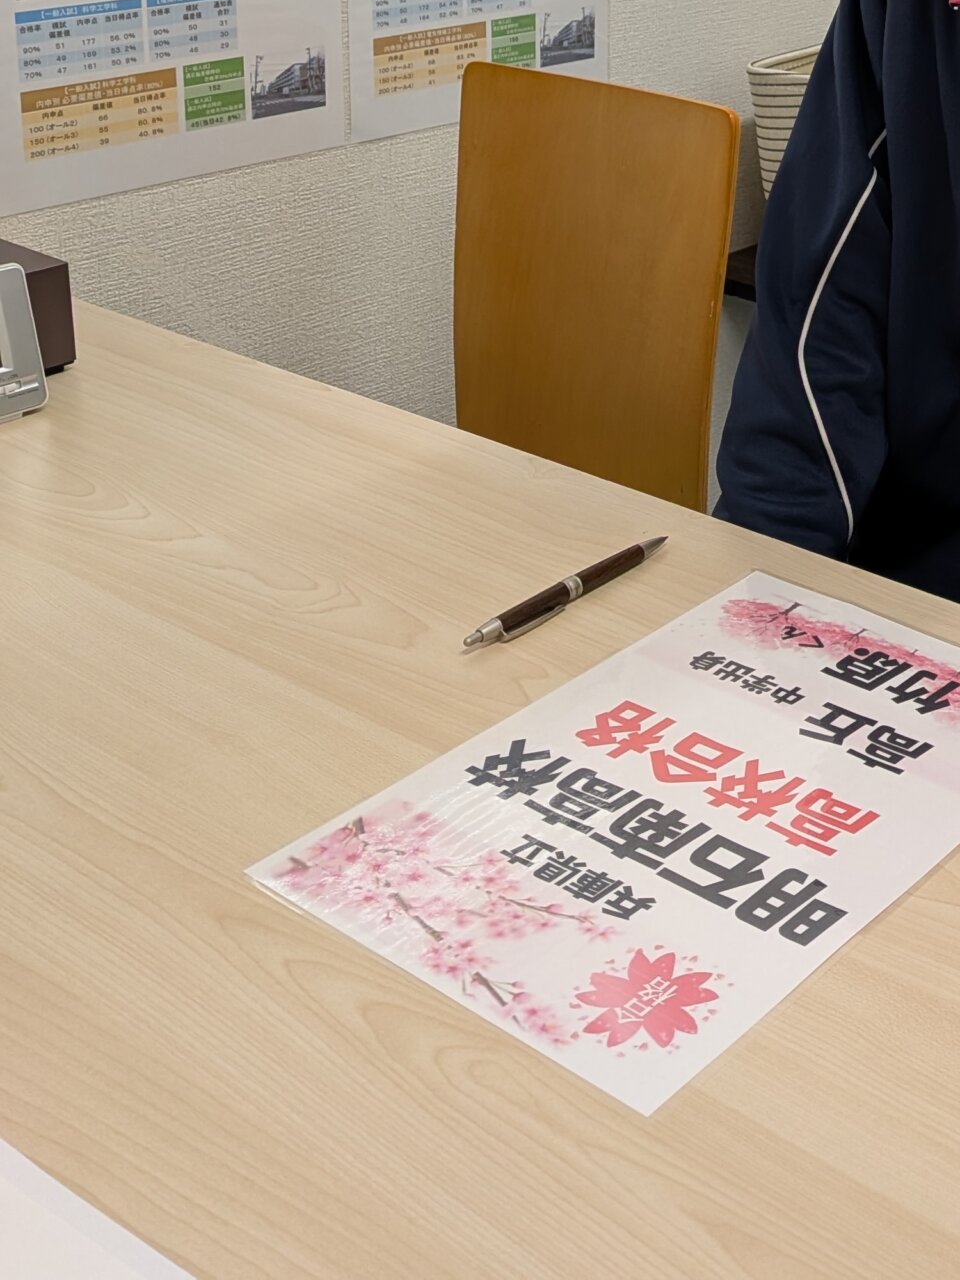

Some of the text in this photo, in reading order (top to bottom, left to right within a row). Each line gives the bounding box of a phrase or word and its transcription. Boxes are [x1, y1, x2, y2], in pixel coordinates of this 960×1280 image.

[22, 46, 41, 55] 90%
[55, 42, 66, 50] 51
[81, 38, 96, 46] 177
[153, 28, 170, 36] 90%
[188, 23, 198, 31] 50
[23, 59, 42, 67] 80%
[55, 55, 67, 63] 49
[154, 51, 171, 59] 70%
[24, 71, 43, 80] 70%
[56, 67, 67, 75] 47
[688, 650, 935, 776] 高丘 中学出身
[575, 700, 881, 857] 高校合格
[464, 738, 849, 947] 明石南高校
[499, 833, 657, 921] 兵庫県立
[615, 975, 681, 1027] 合格
